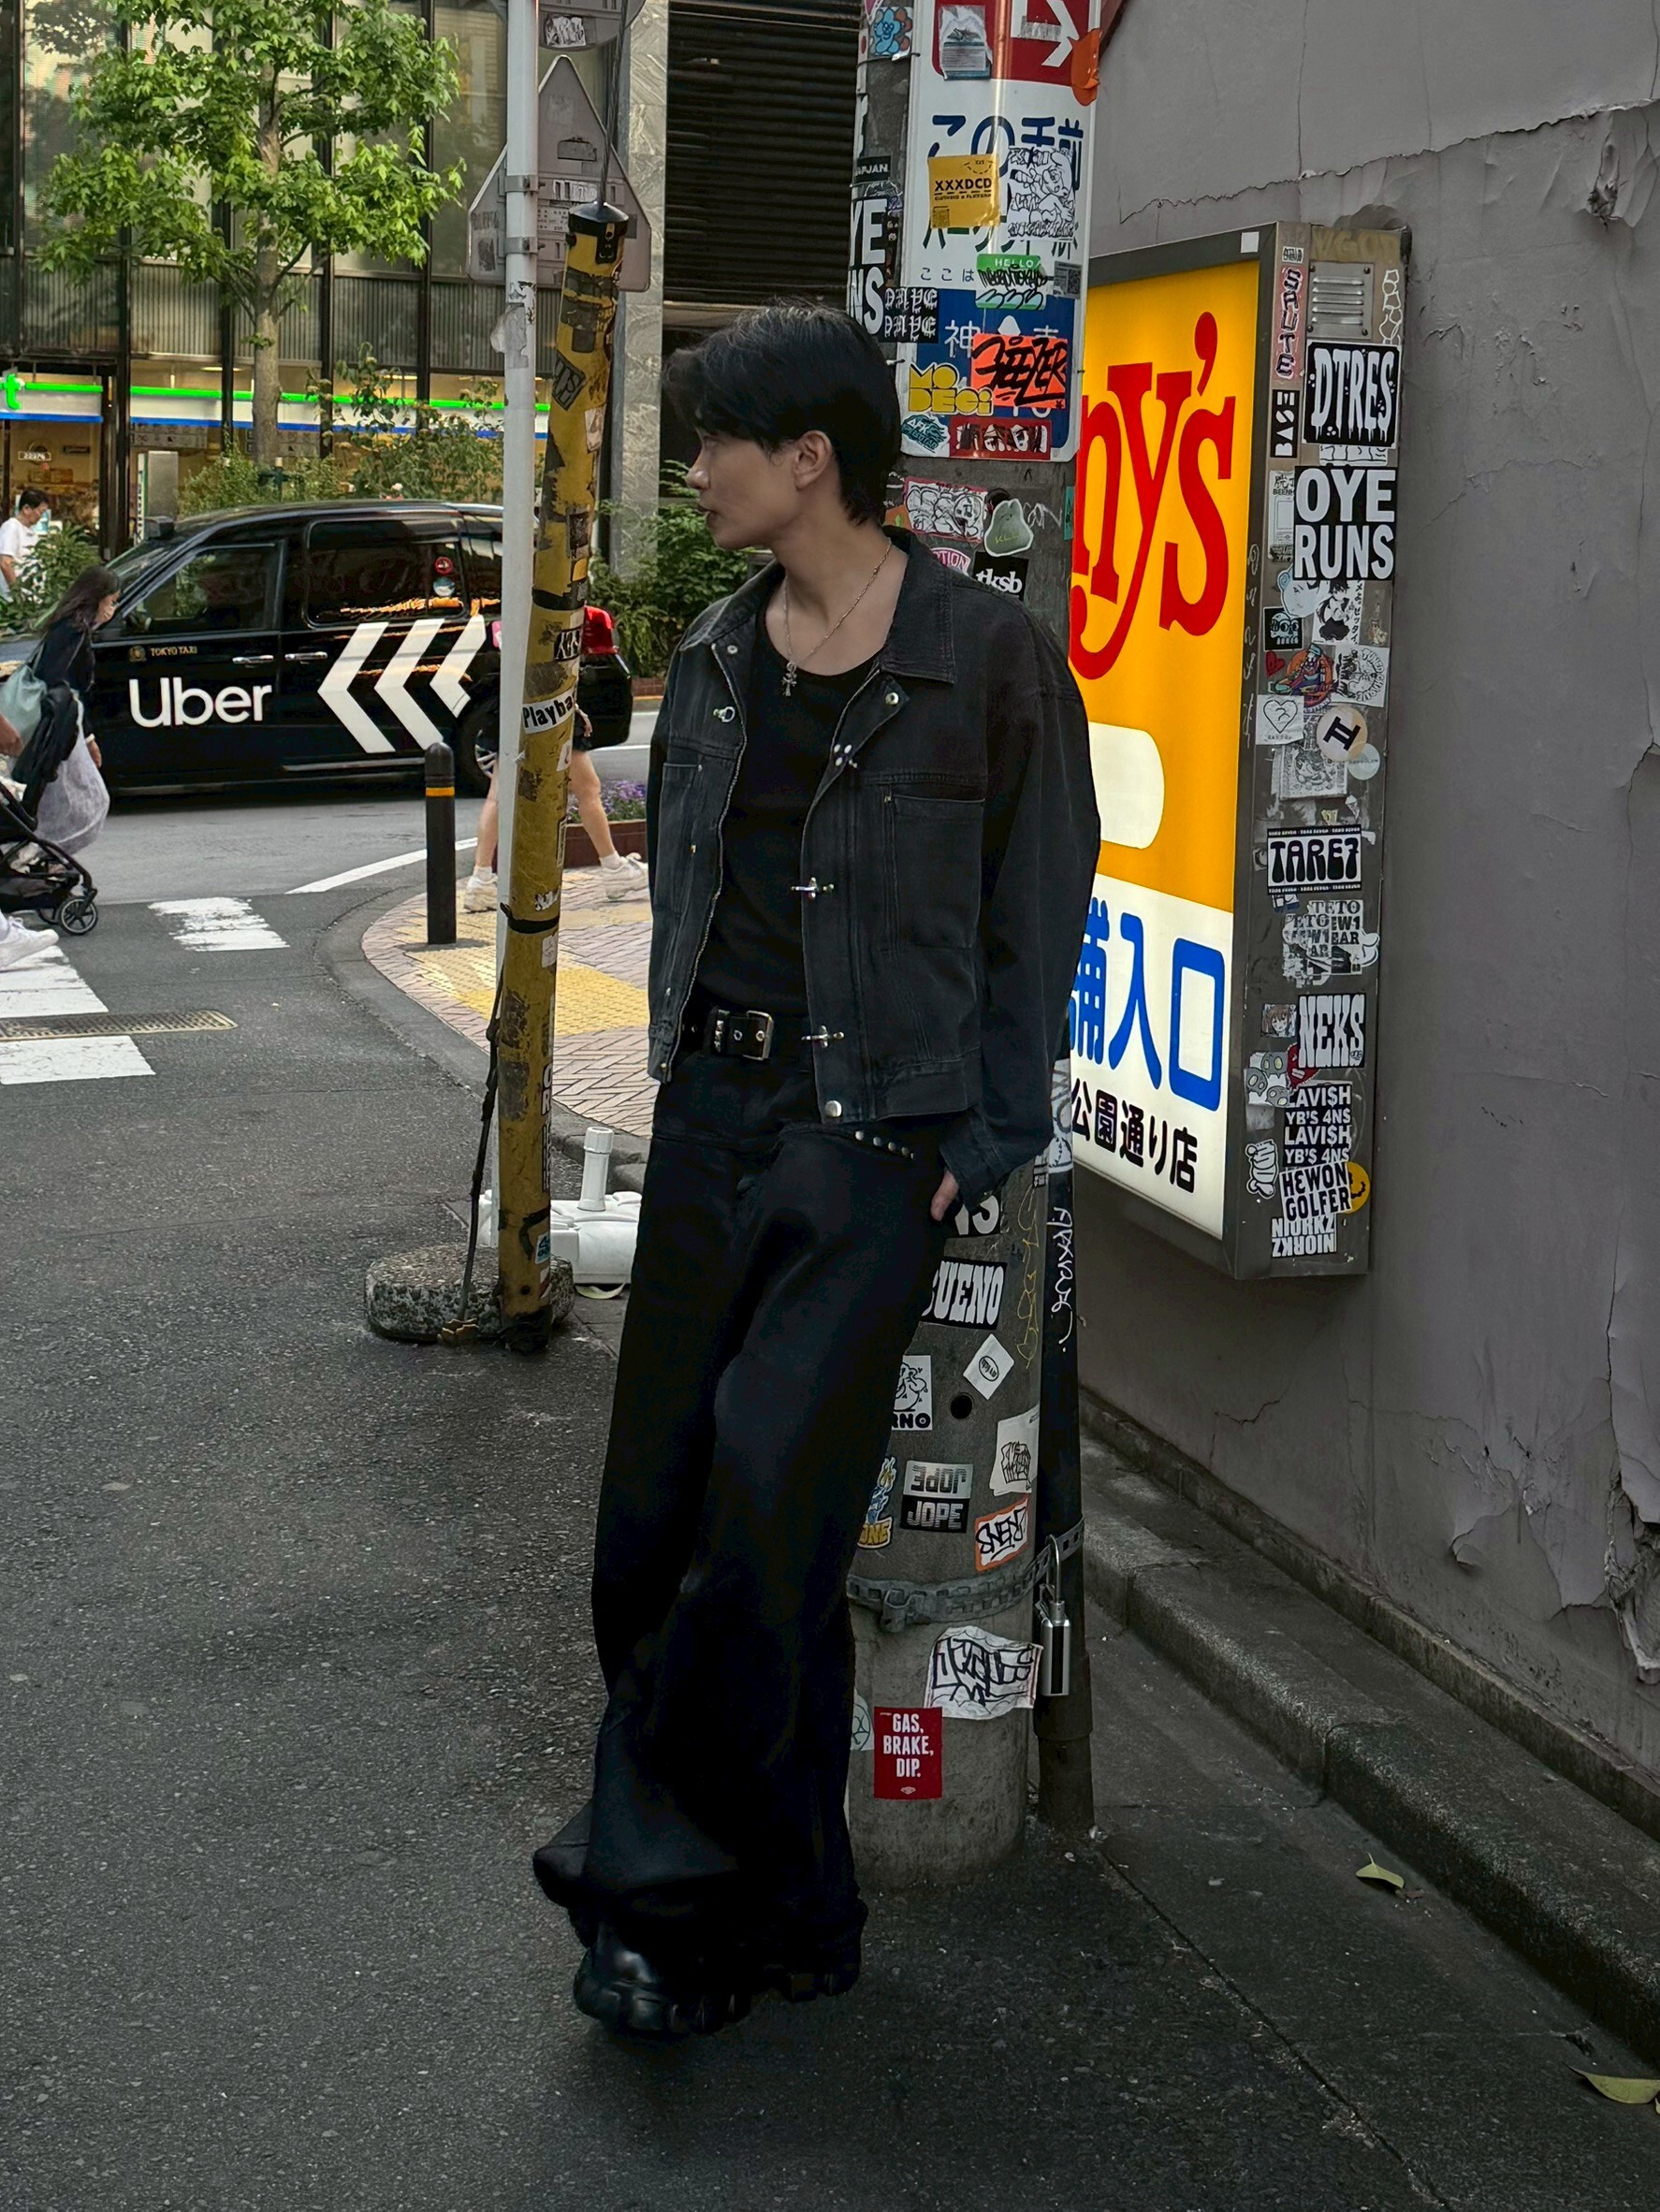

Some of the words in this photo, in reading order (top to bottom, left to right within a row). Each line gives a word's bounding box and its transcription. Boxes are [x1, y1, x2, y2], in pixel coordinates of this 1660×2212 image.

[934, 177, 992, 192] XXXDCD
[851, 198, 888, 266] YE
[920, 266, 975, 283] ここは
[847, 266, 884, 335] NS
[1070, 311, 1237, 680] ny's
[1295, 468, 1396, 523] OYE
[1294, 524, 1395, 580] RUNS
[150, 647, 178, 657] TOKYO
[178, 646, 198, 654] TAXI
[129, 677, 272, 728] Uber
[522, 695, 574, 729] Playba
[1069, 895, 1225, 1112] 舗入口
[1298, 994, 1365, 1068] NEKS
[1071, 1076, 1199, 1194] 公園通り店
[1285, 1186, 1351, 1222] GOLFER
[906, 1500, 964, 1528] JOPE
[882, 1735, 935, 1756] BRAKE,
[896, 1757, 922, 1778] DIP.
